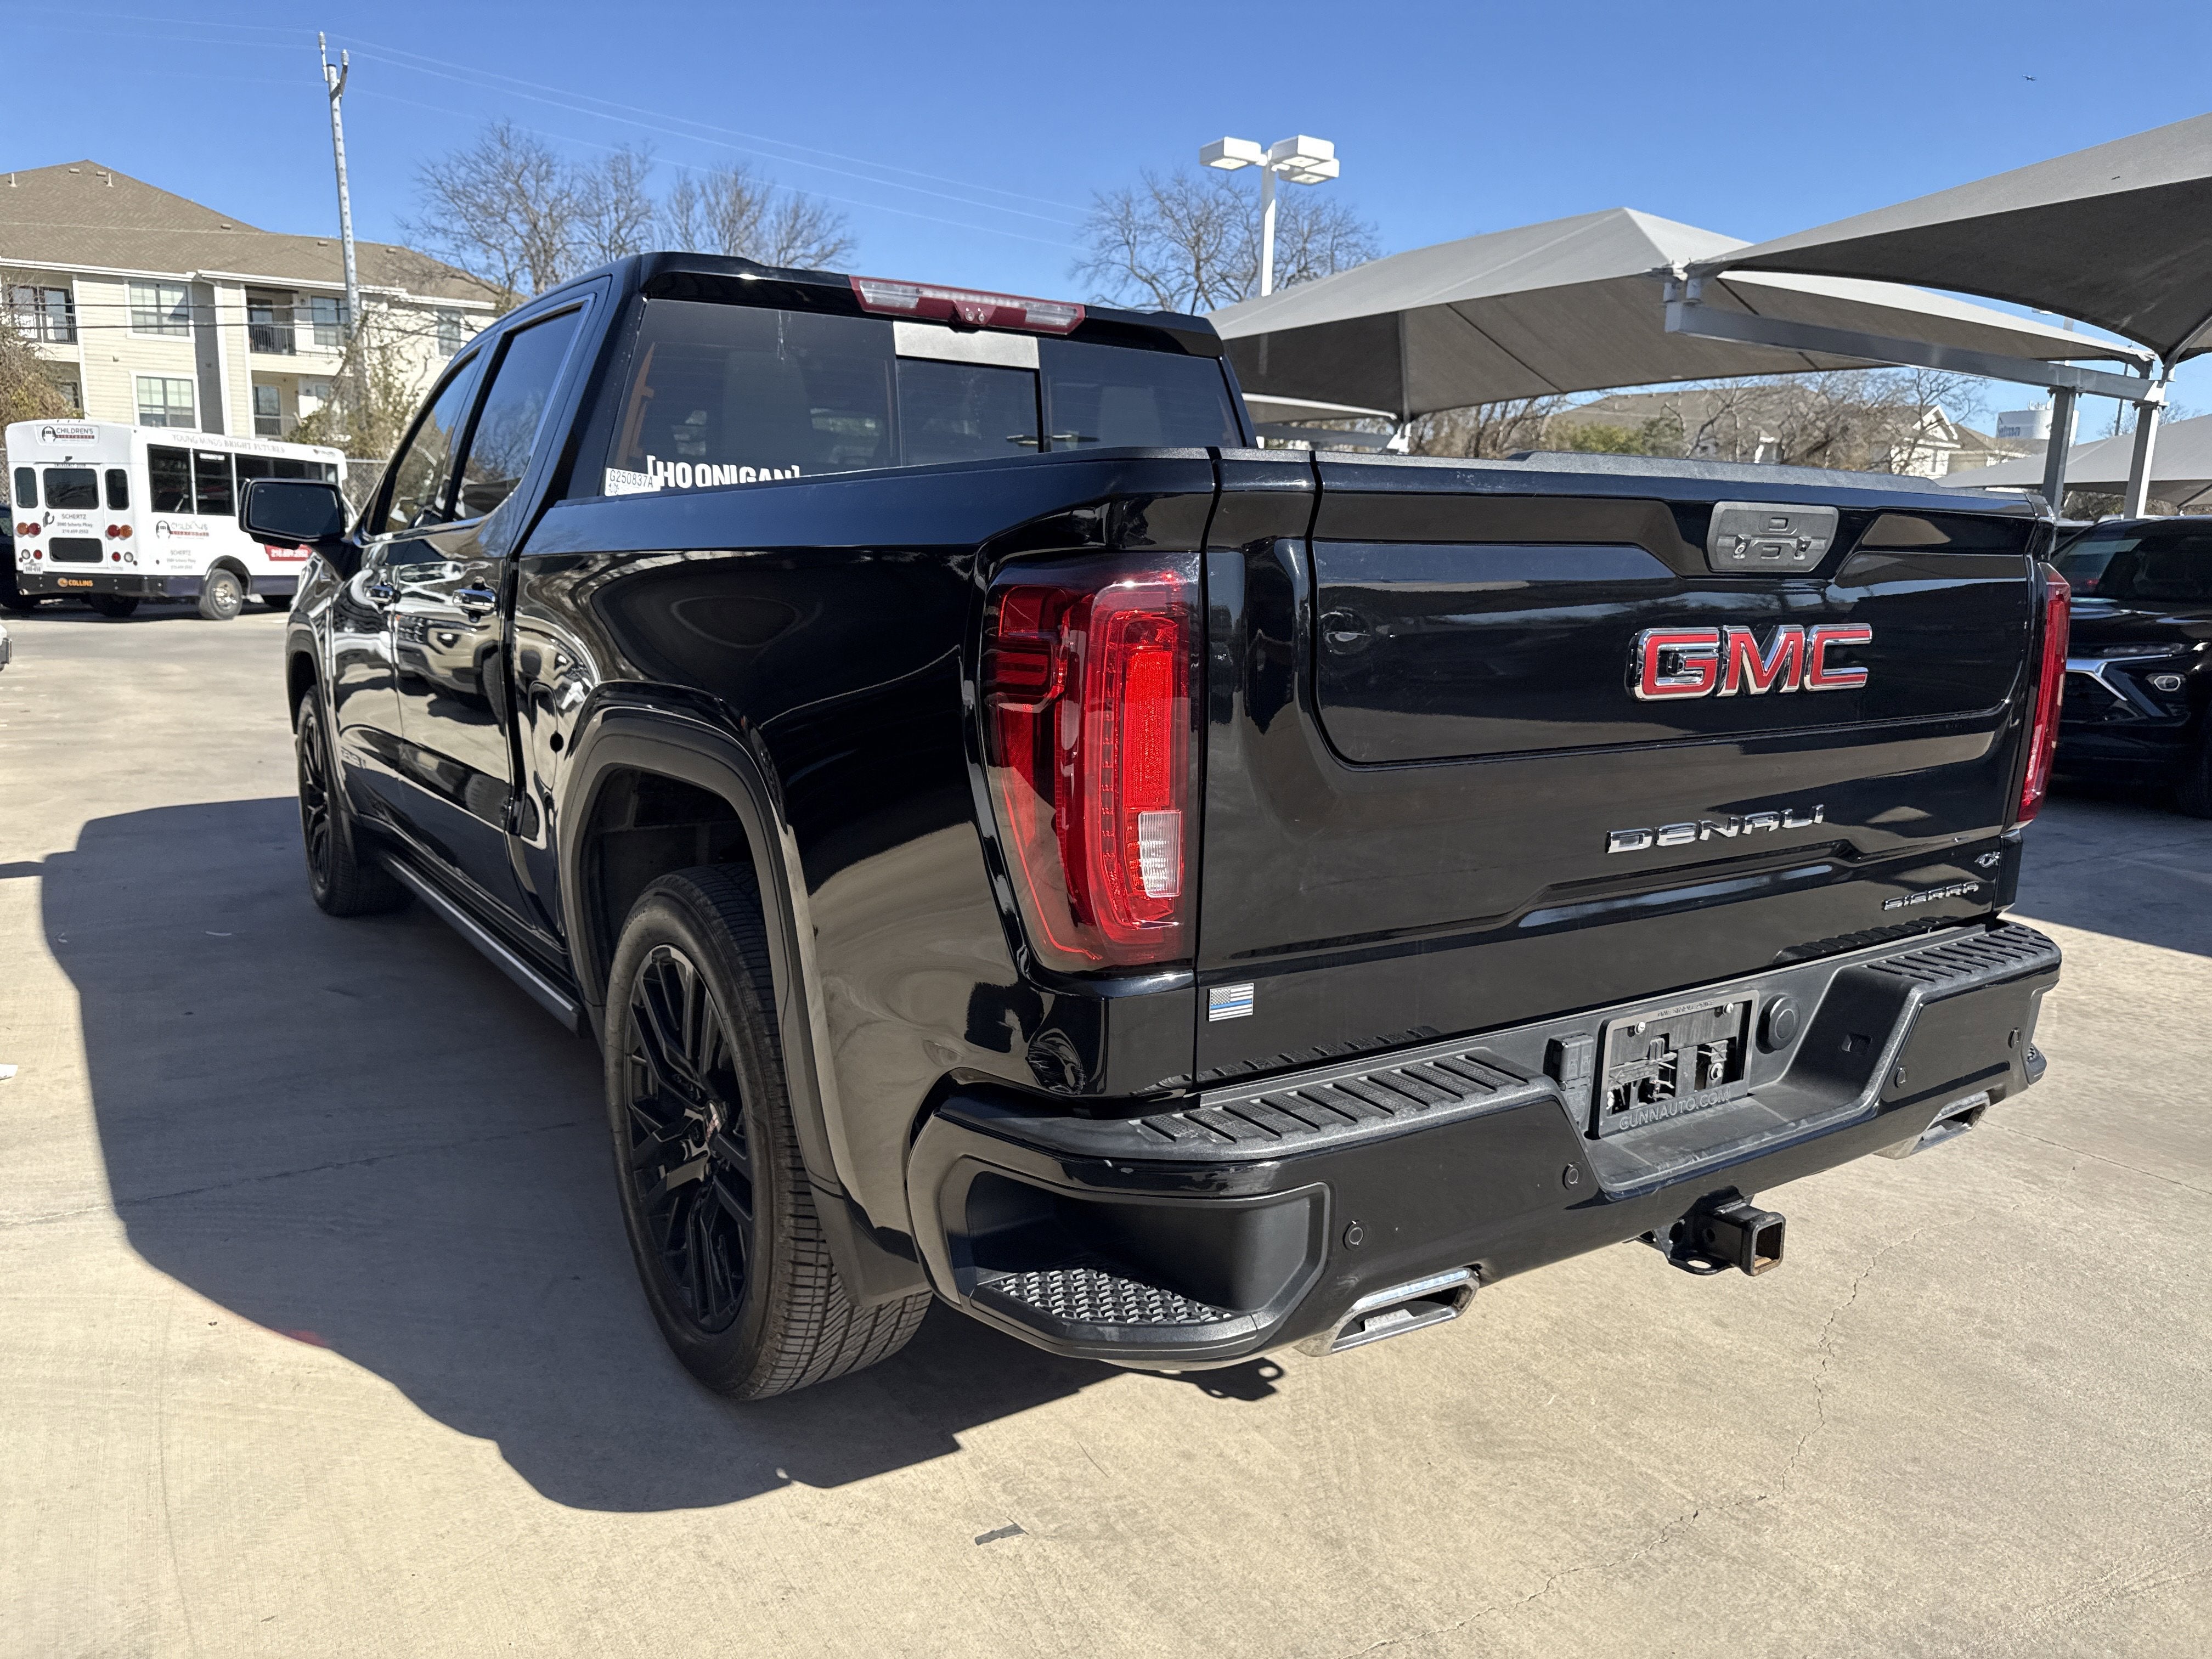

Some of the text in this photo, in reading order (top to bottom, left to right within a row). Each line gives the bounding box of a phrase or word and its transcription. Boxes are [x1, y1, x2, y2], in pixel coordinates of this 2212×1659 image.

[172, 434, 198, 444] YOUNG
[224, 439, 251, 449] BRIGHT
[610, 470, 653, 488] G250837A
[1624, 623, 1872, 702] GMC
[1606, 804, 1825, 853] DENALI
[1882, 881, 1979, 910] SIERRA
[1619, 1087, 1730, 1130] GUNNAUTO.COM
